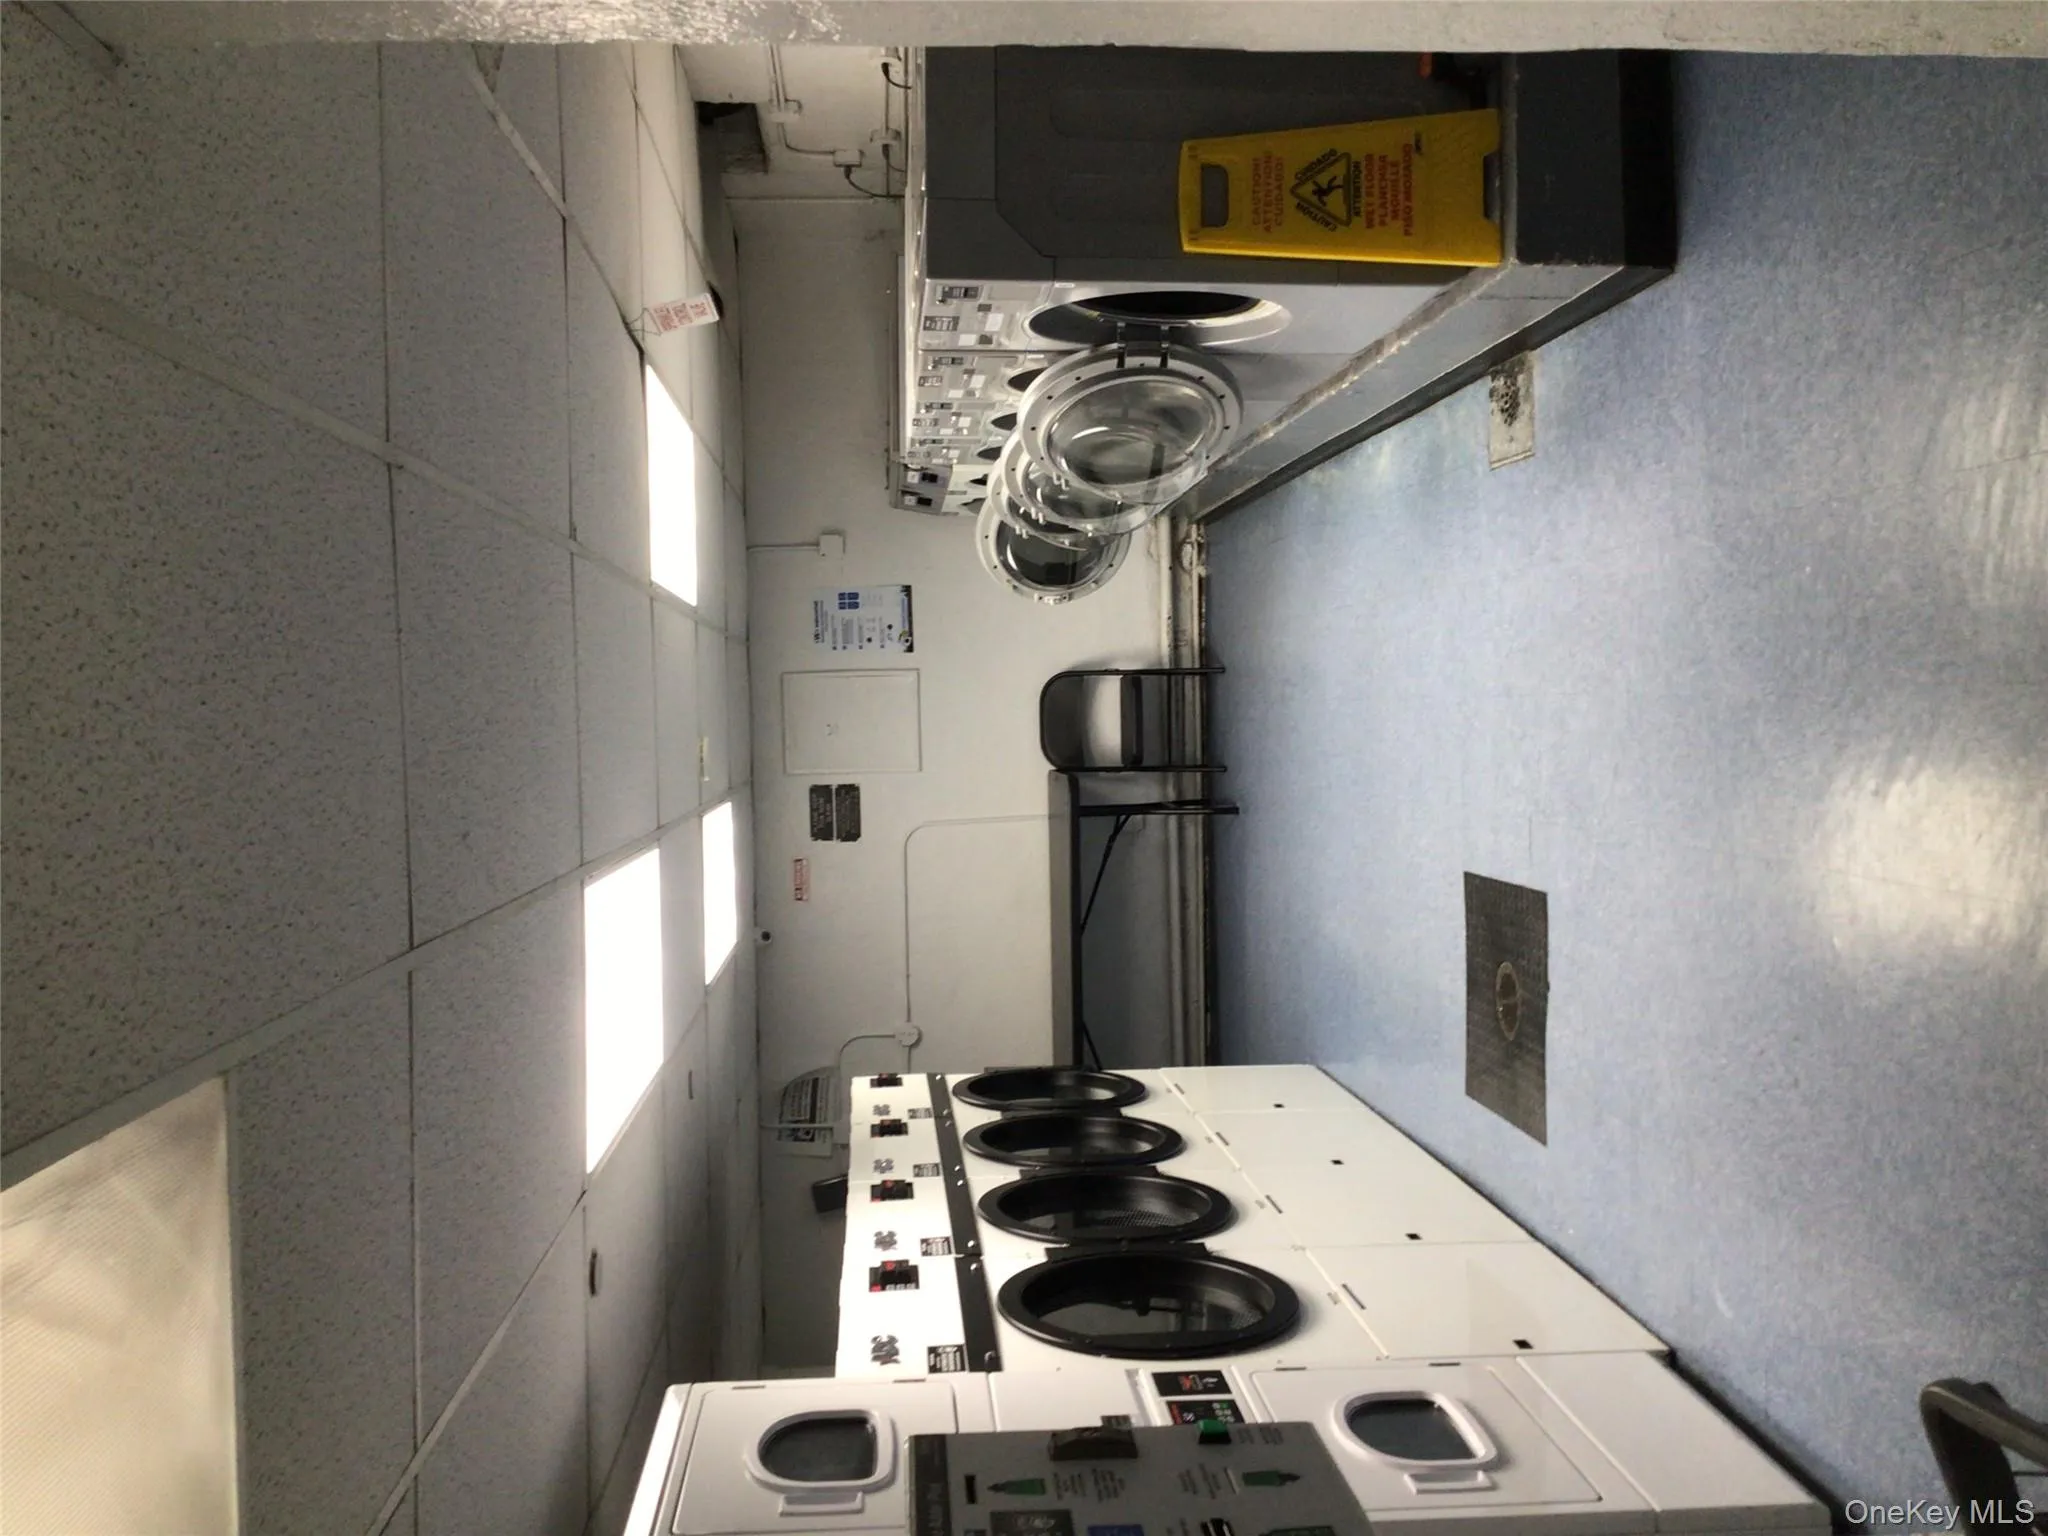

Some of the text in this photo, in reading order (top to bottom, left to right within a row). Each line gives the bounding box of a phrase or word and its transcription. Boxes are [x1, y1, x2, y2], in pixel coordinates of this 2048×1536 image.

[1252, 157, 1262, 226] CAUTION!
[1352, 160, 1362, 218] ATTENTION
[1364, 153, 1375, 229] WET FLOOR
[1402, 143, 1413, 236] PISO MOJADO
